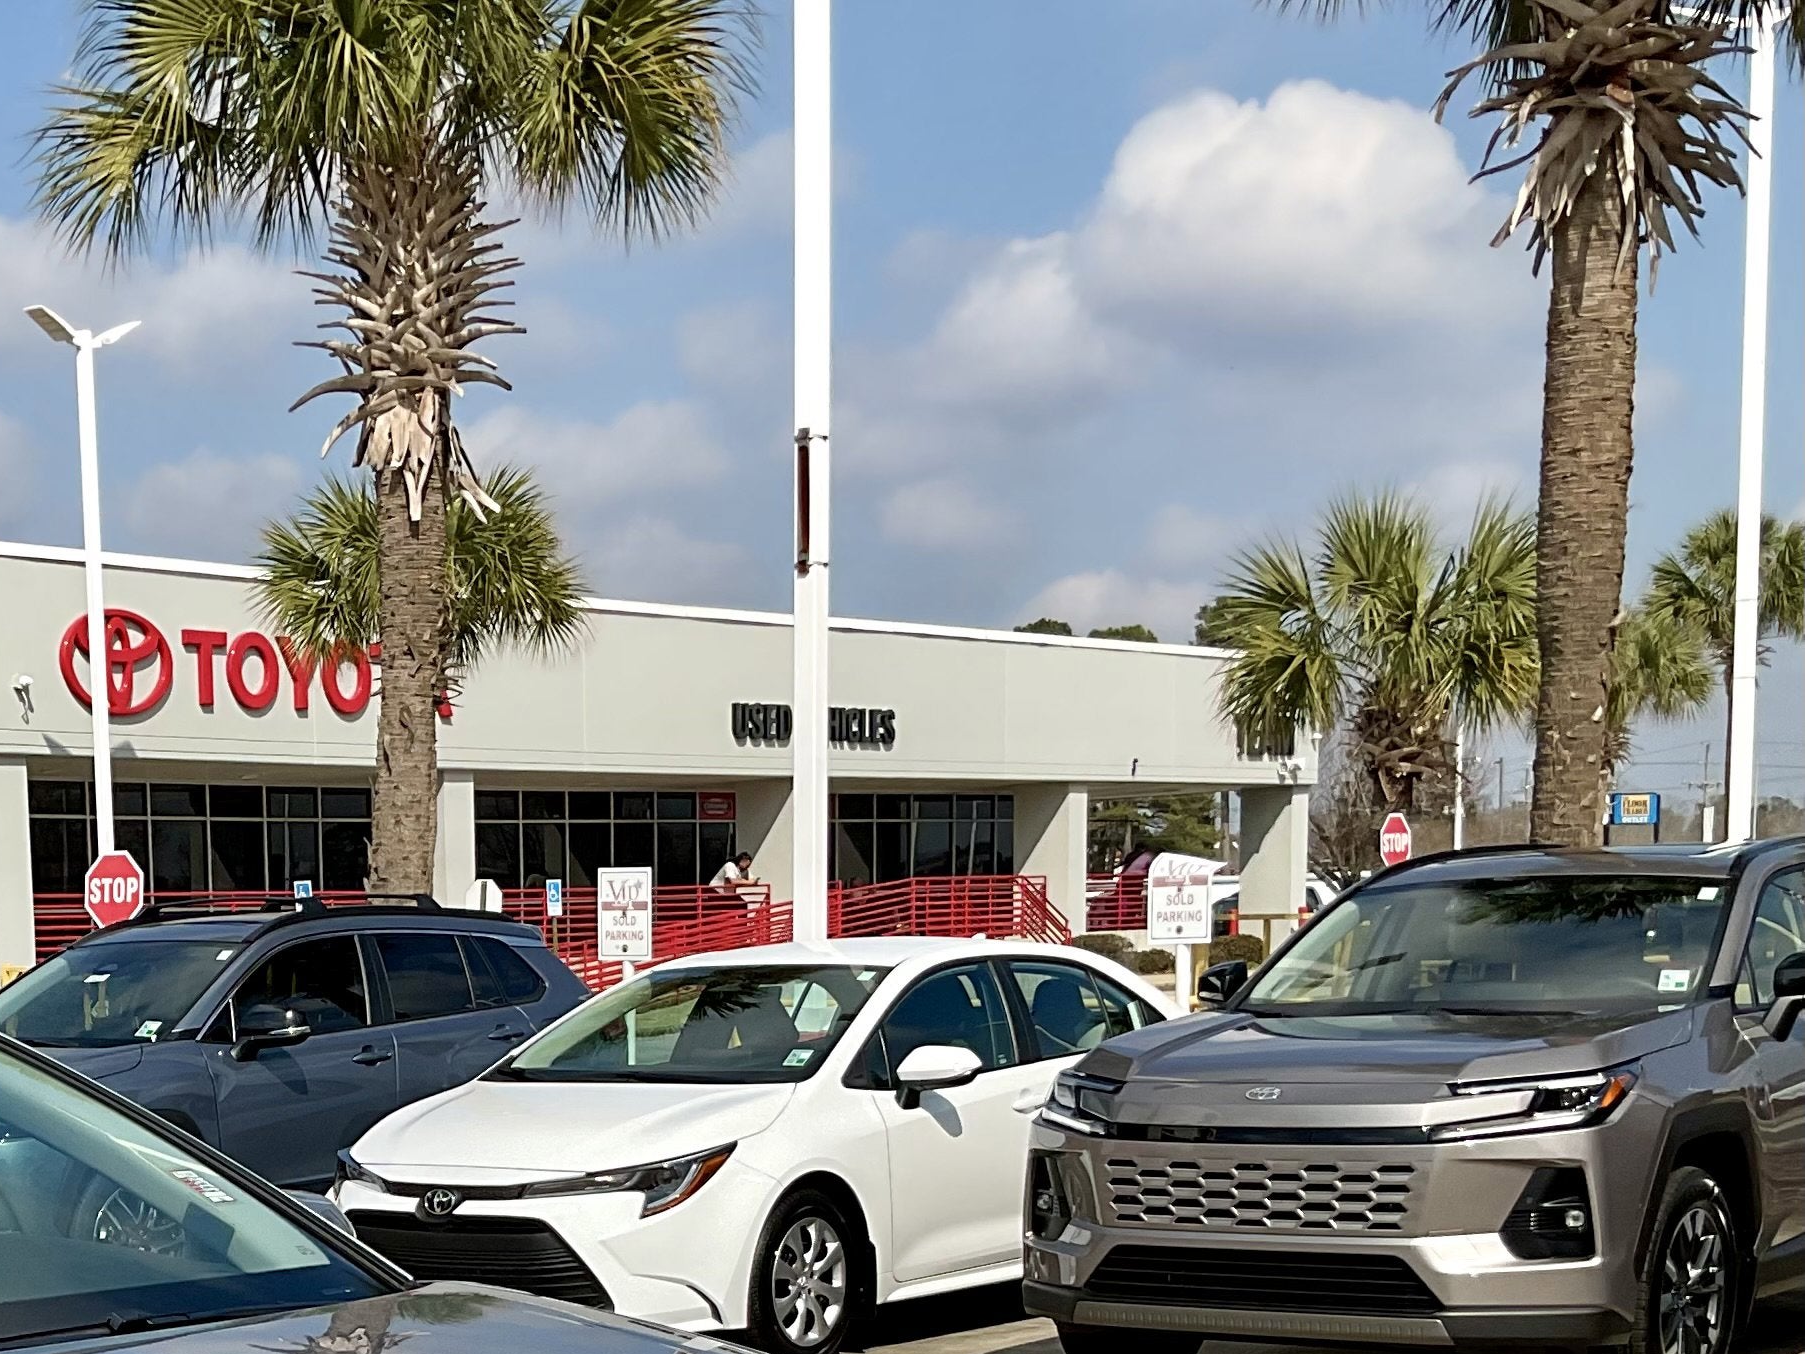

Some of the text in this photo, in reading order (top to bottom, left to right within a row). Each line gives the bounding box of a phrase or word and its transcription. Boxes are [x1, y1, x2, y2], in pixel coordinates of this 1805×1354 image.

[181, 629, 453, 717] TOYO
[731, 703, 895, 745] USED HICLES
[1383, 832, 1408, 853] STOP
[89, 876, 139, 905] STOP
[1166, 894, 1194, 906] SOLD
[612, 915, 637, 927] SOLD
[1156, 910, 1203, 923] PARKING
[605, 930, 644, 941] PARKING
